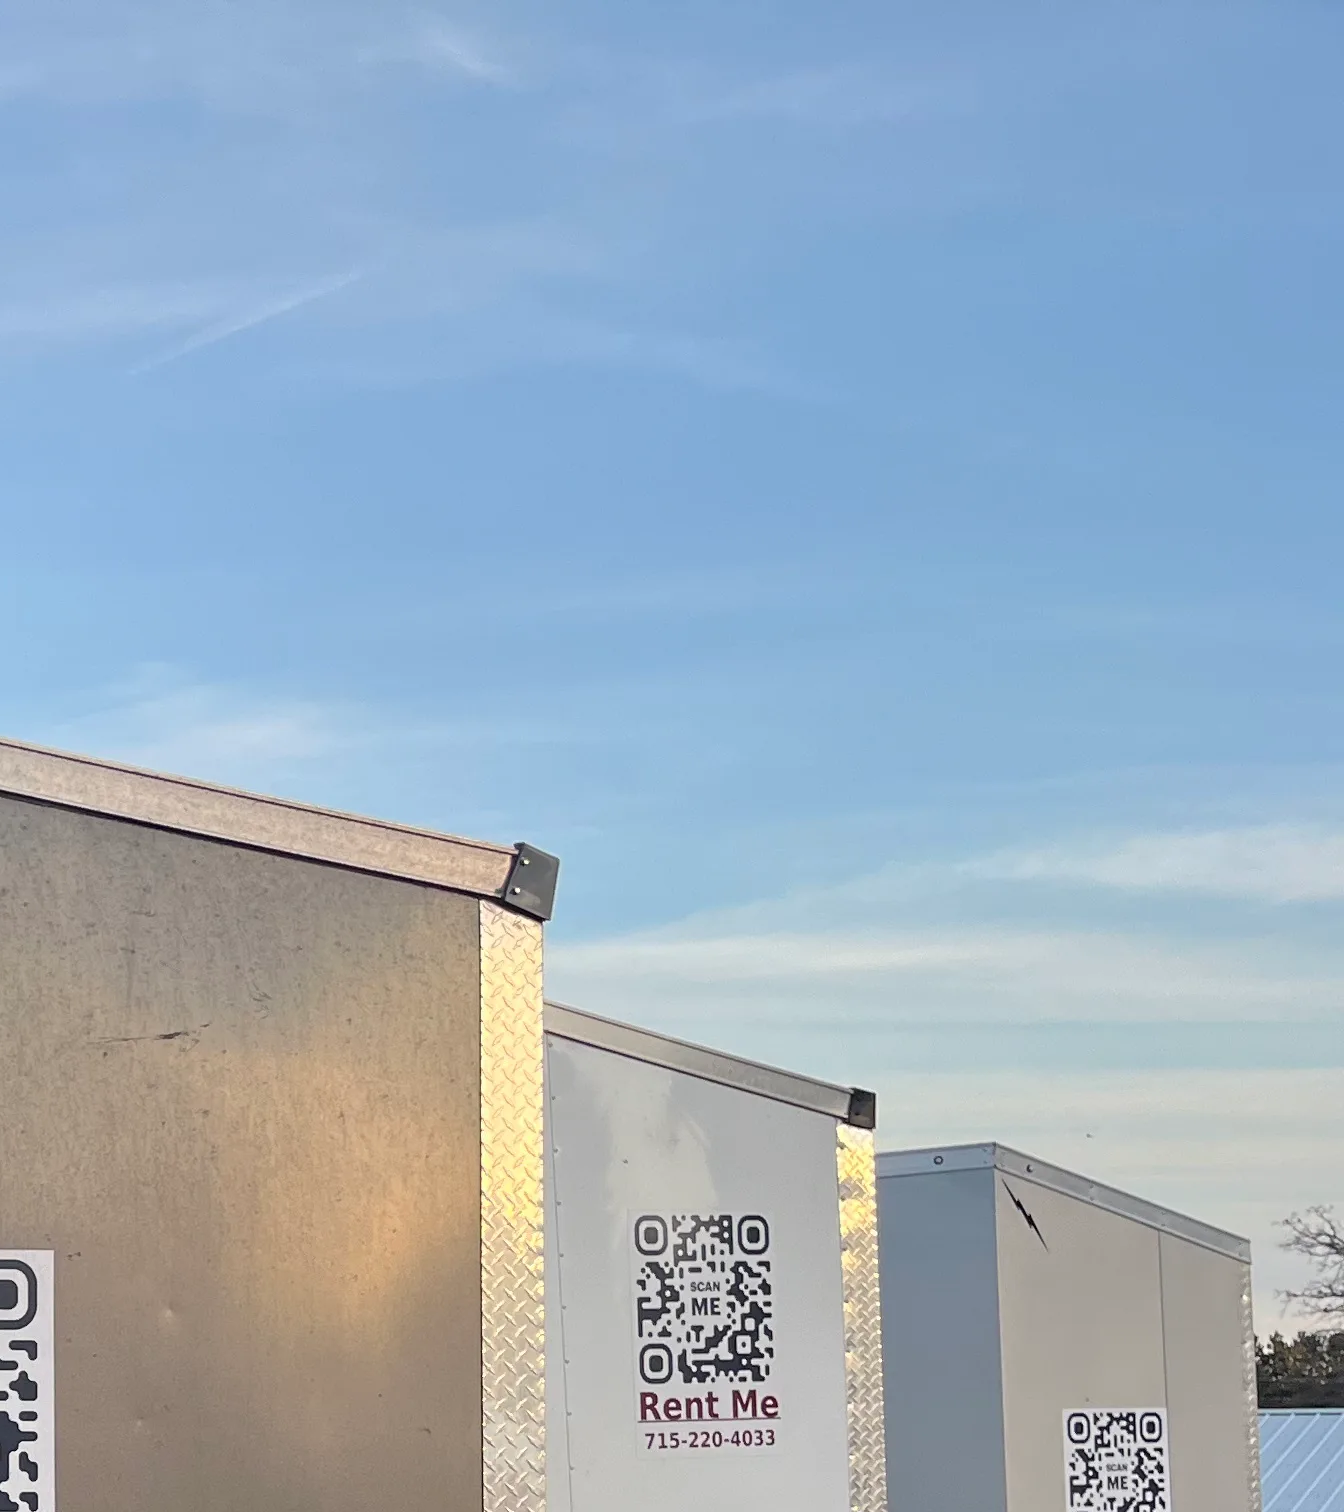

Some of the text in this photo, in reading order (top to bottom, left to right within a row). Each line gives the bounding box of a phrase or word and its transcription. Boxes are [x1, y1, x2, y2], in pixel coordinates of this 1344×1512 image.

[690, 1281, 721, 1292] SCAN
[691, 1297, 721, 1316] ME
[639, 1390, 779, 1421] Rent Me
[645, 1429, 775, 1449] 715-220-4033
[1106, 1463, 1128, 1472] SCAN
[1107, 1476, 1128, 1490] ME
